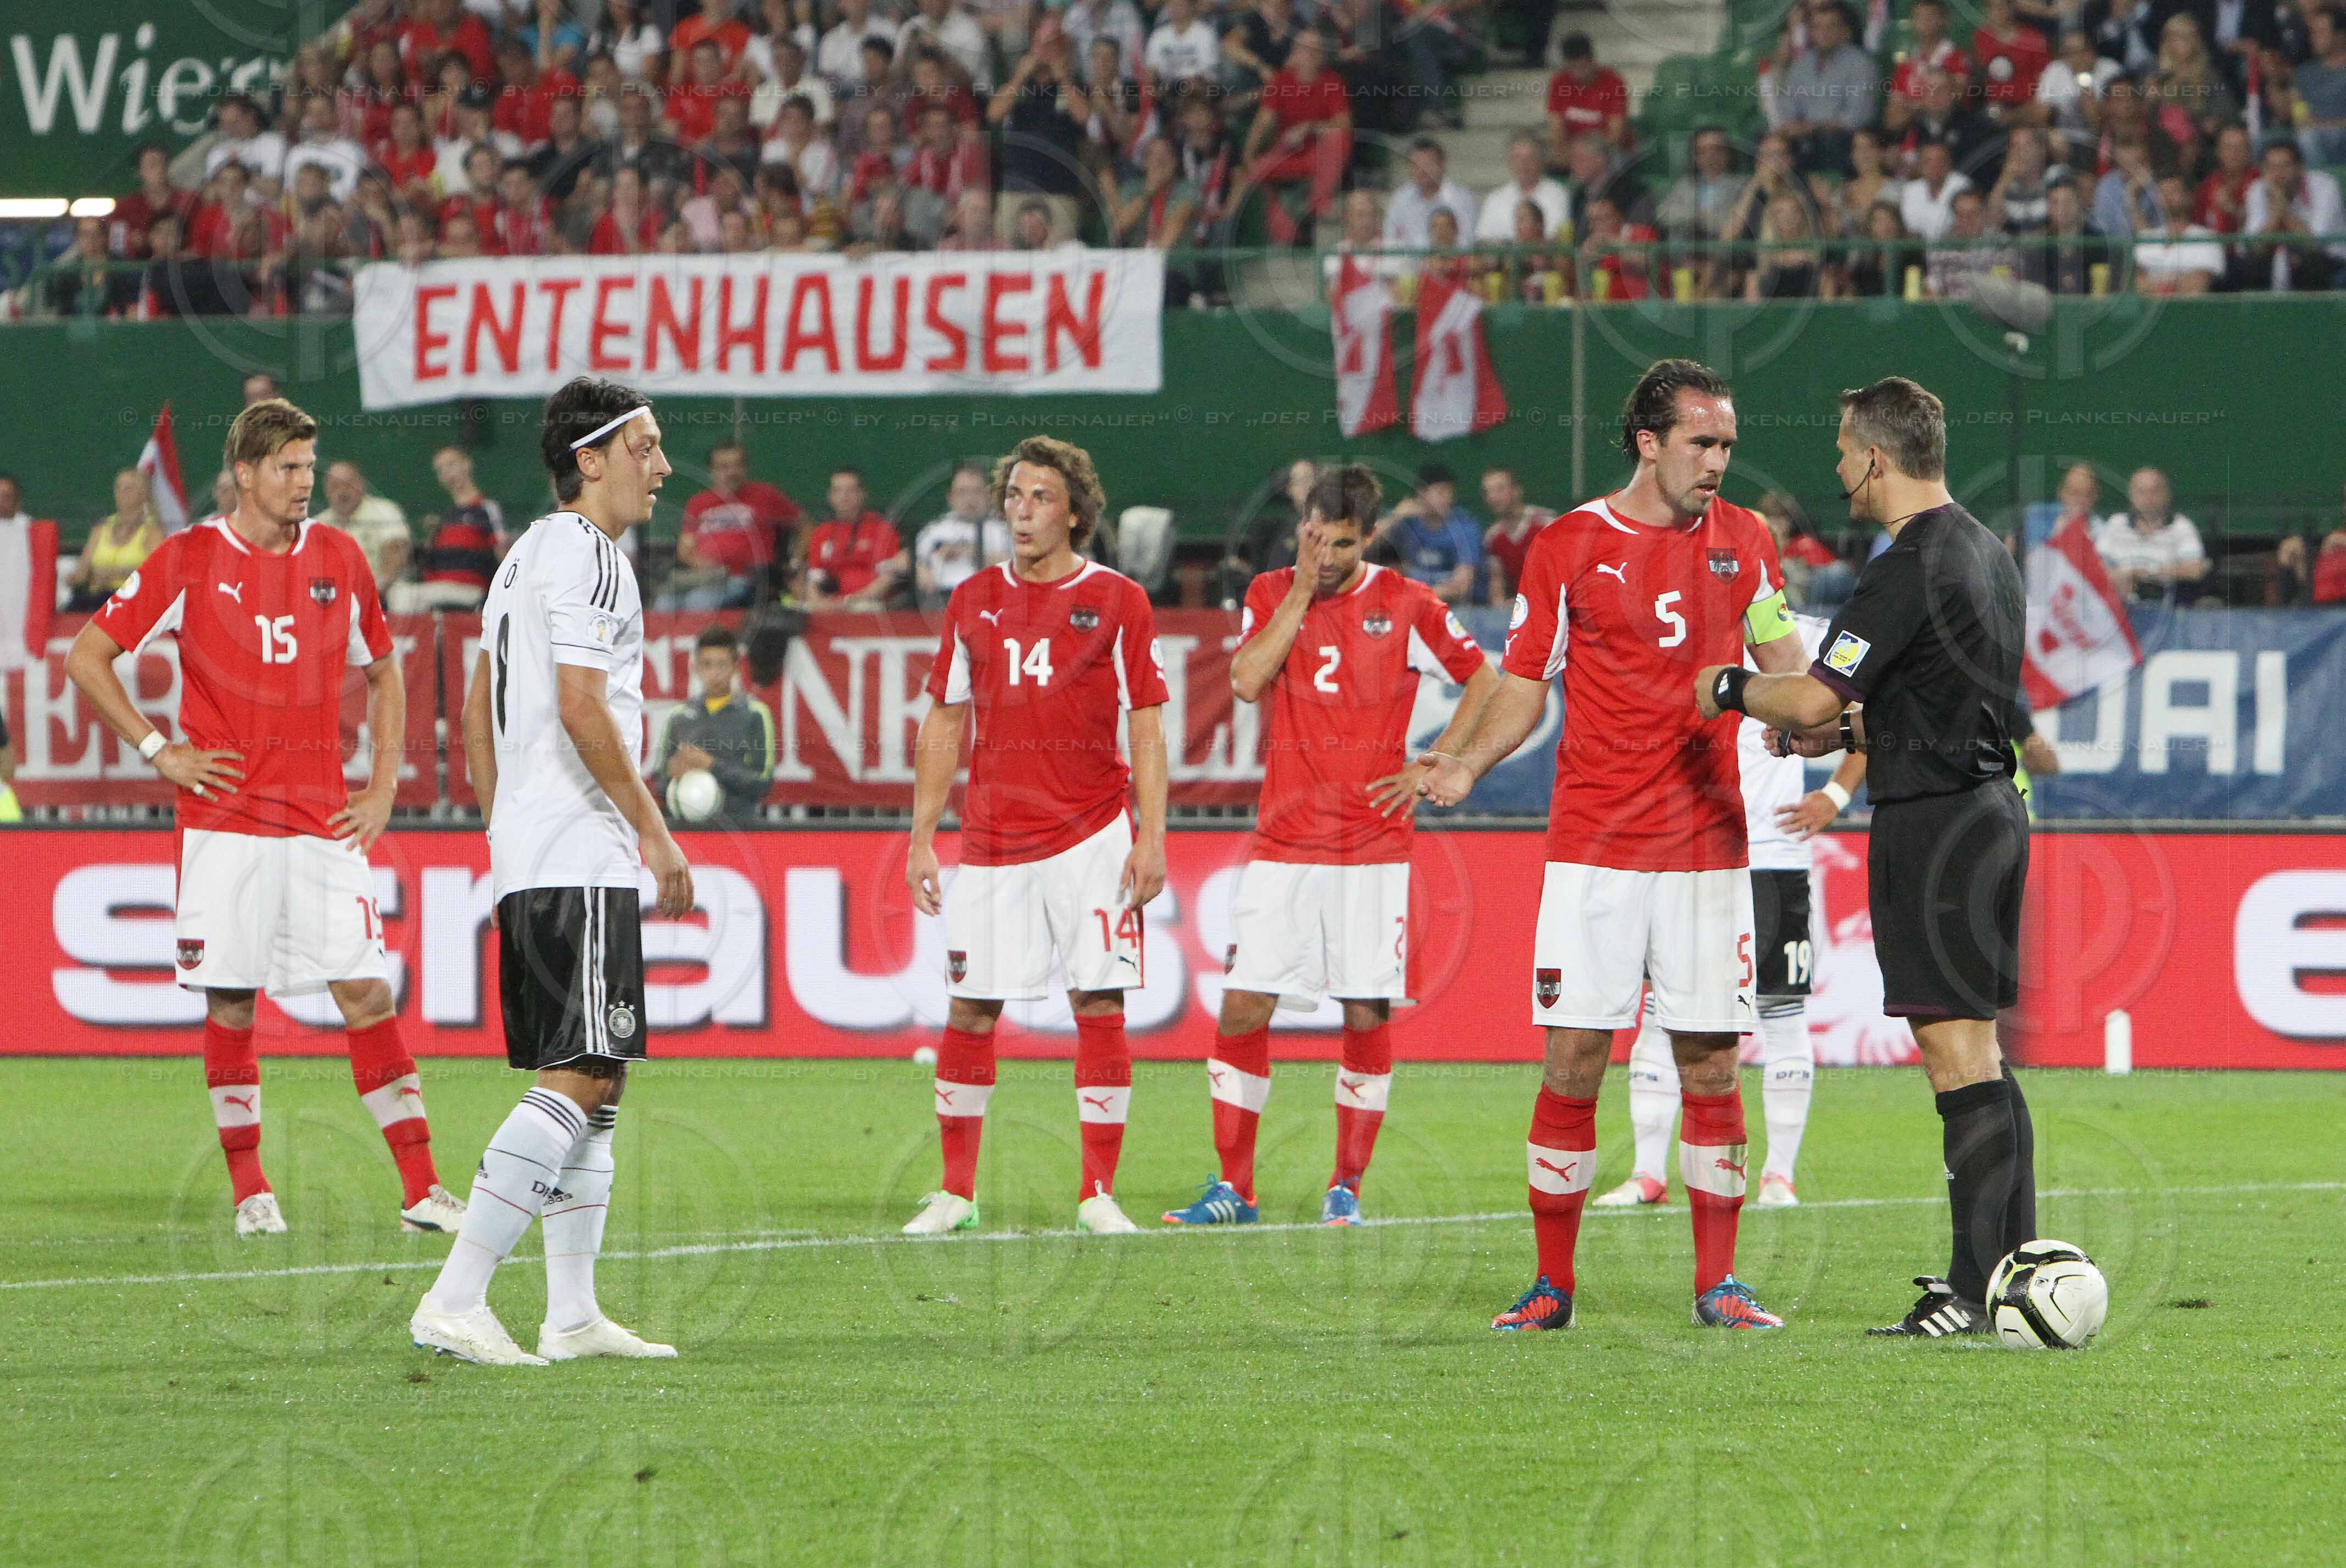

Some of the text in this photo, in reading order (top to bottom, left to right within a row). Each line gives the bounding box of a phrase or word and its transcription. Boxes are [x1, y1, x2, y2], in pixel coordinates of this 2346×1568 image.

[413, 272, 1107, 381] ENTENHAUSEN
[254, 614, 298, 664] 15
[1655, 590, 1686, 647] 5
[1003, 637, 1054, 686] 14
[1313, 645, 1342, 693] 2
[1093, 902, 1137, 952] 14
[1737, 933, 1752, 987] 5
[1784, 939, 1811, 985] 19
